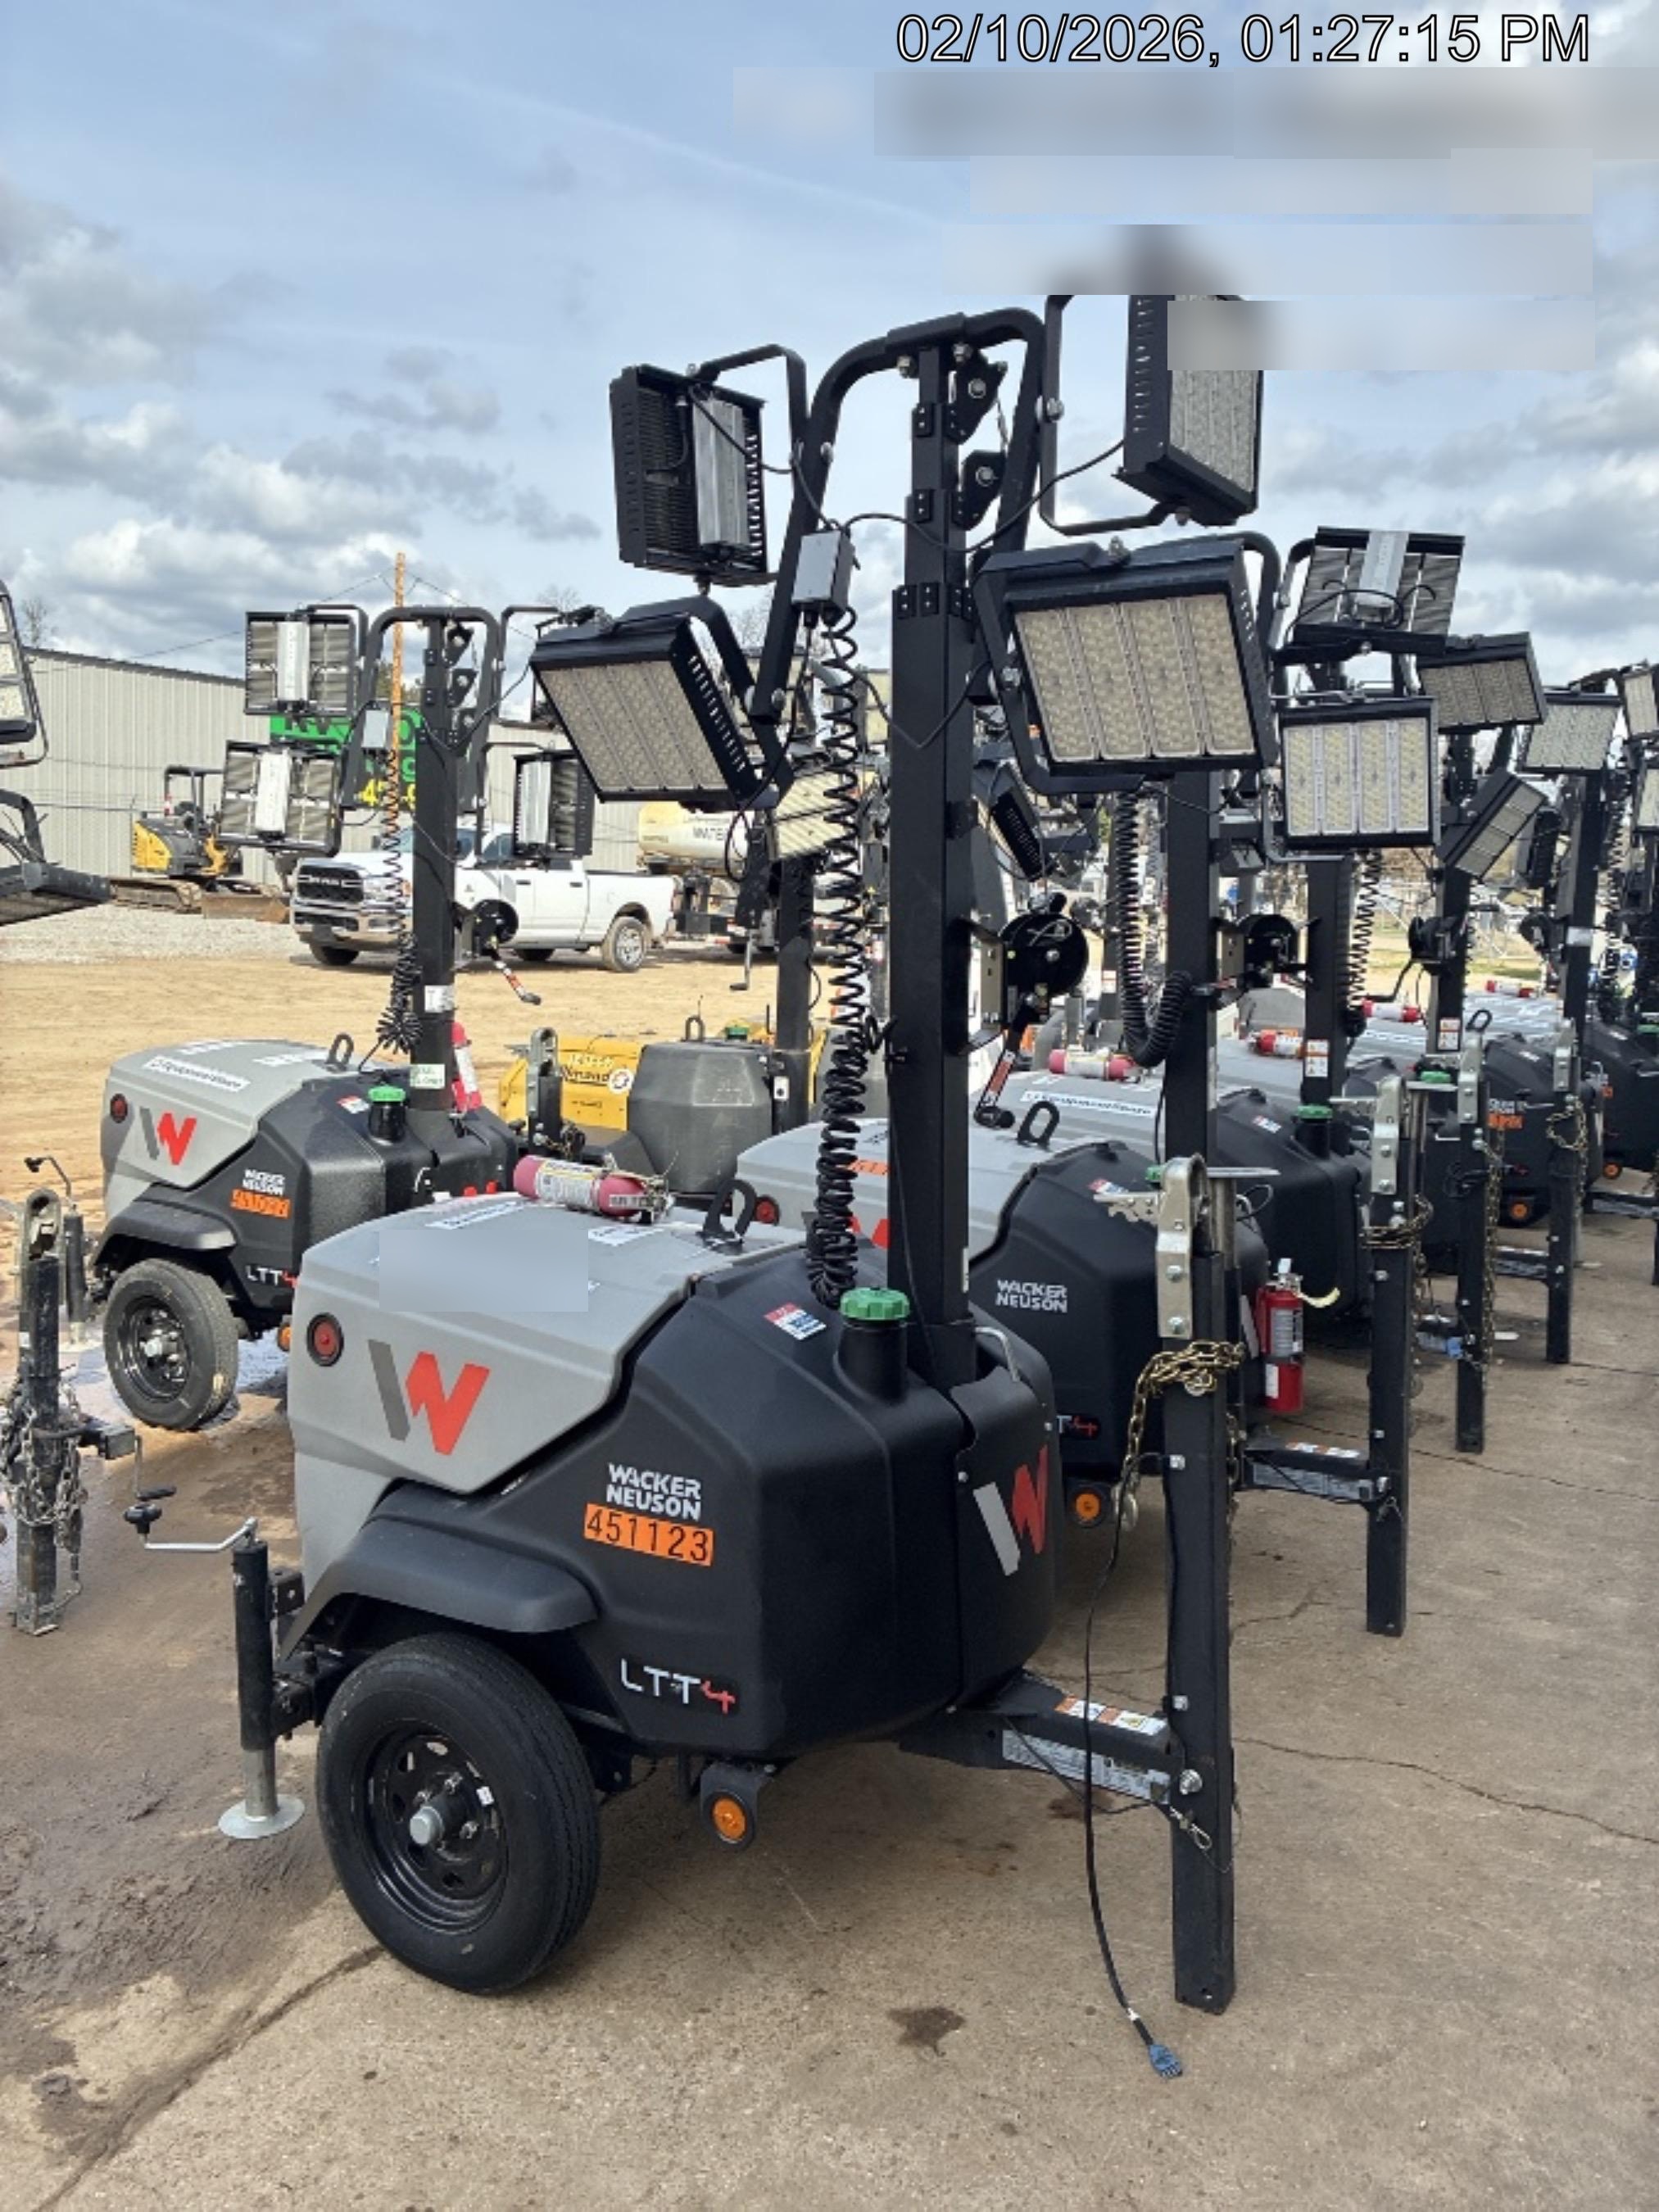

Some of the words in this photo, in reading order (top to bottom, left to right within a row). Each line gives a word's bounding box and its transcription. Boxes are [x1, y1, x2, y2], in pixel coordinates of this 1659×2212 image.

[995, 1293, 1067, 1312] NEUSON
[996, 1279, 1067, 1299] WACKER
[1057, 1414, 1098, 1438] T4
[608, 1462, 701, 1499] WACKER
[606, 1484, 702, 1521] NEUSON
[587, 1508, 709, 1562] 451123
